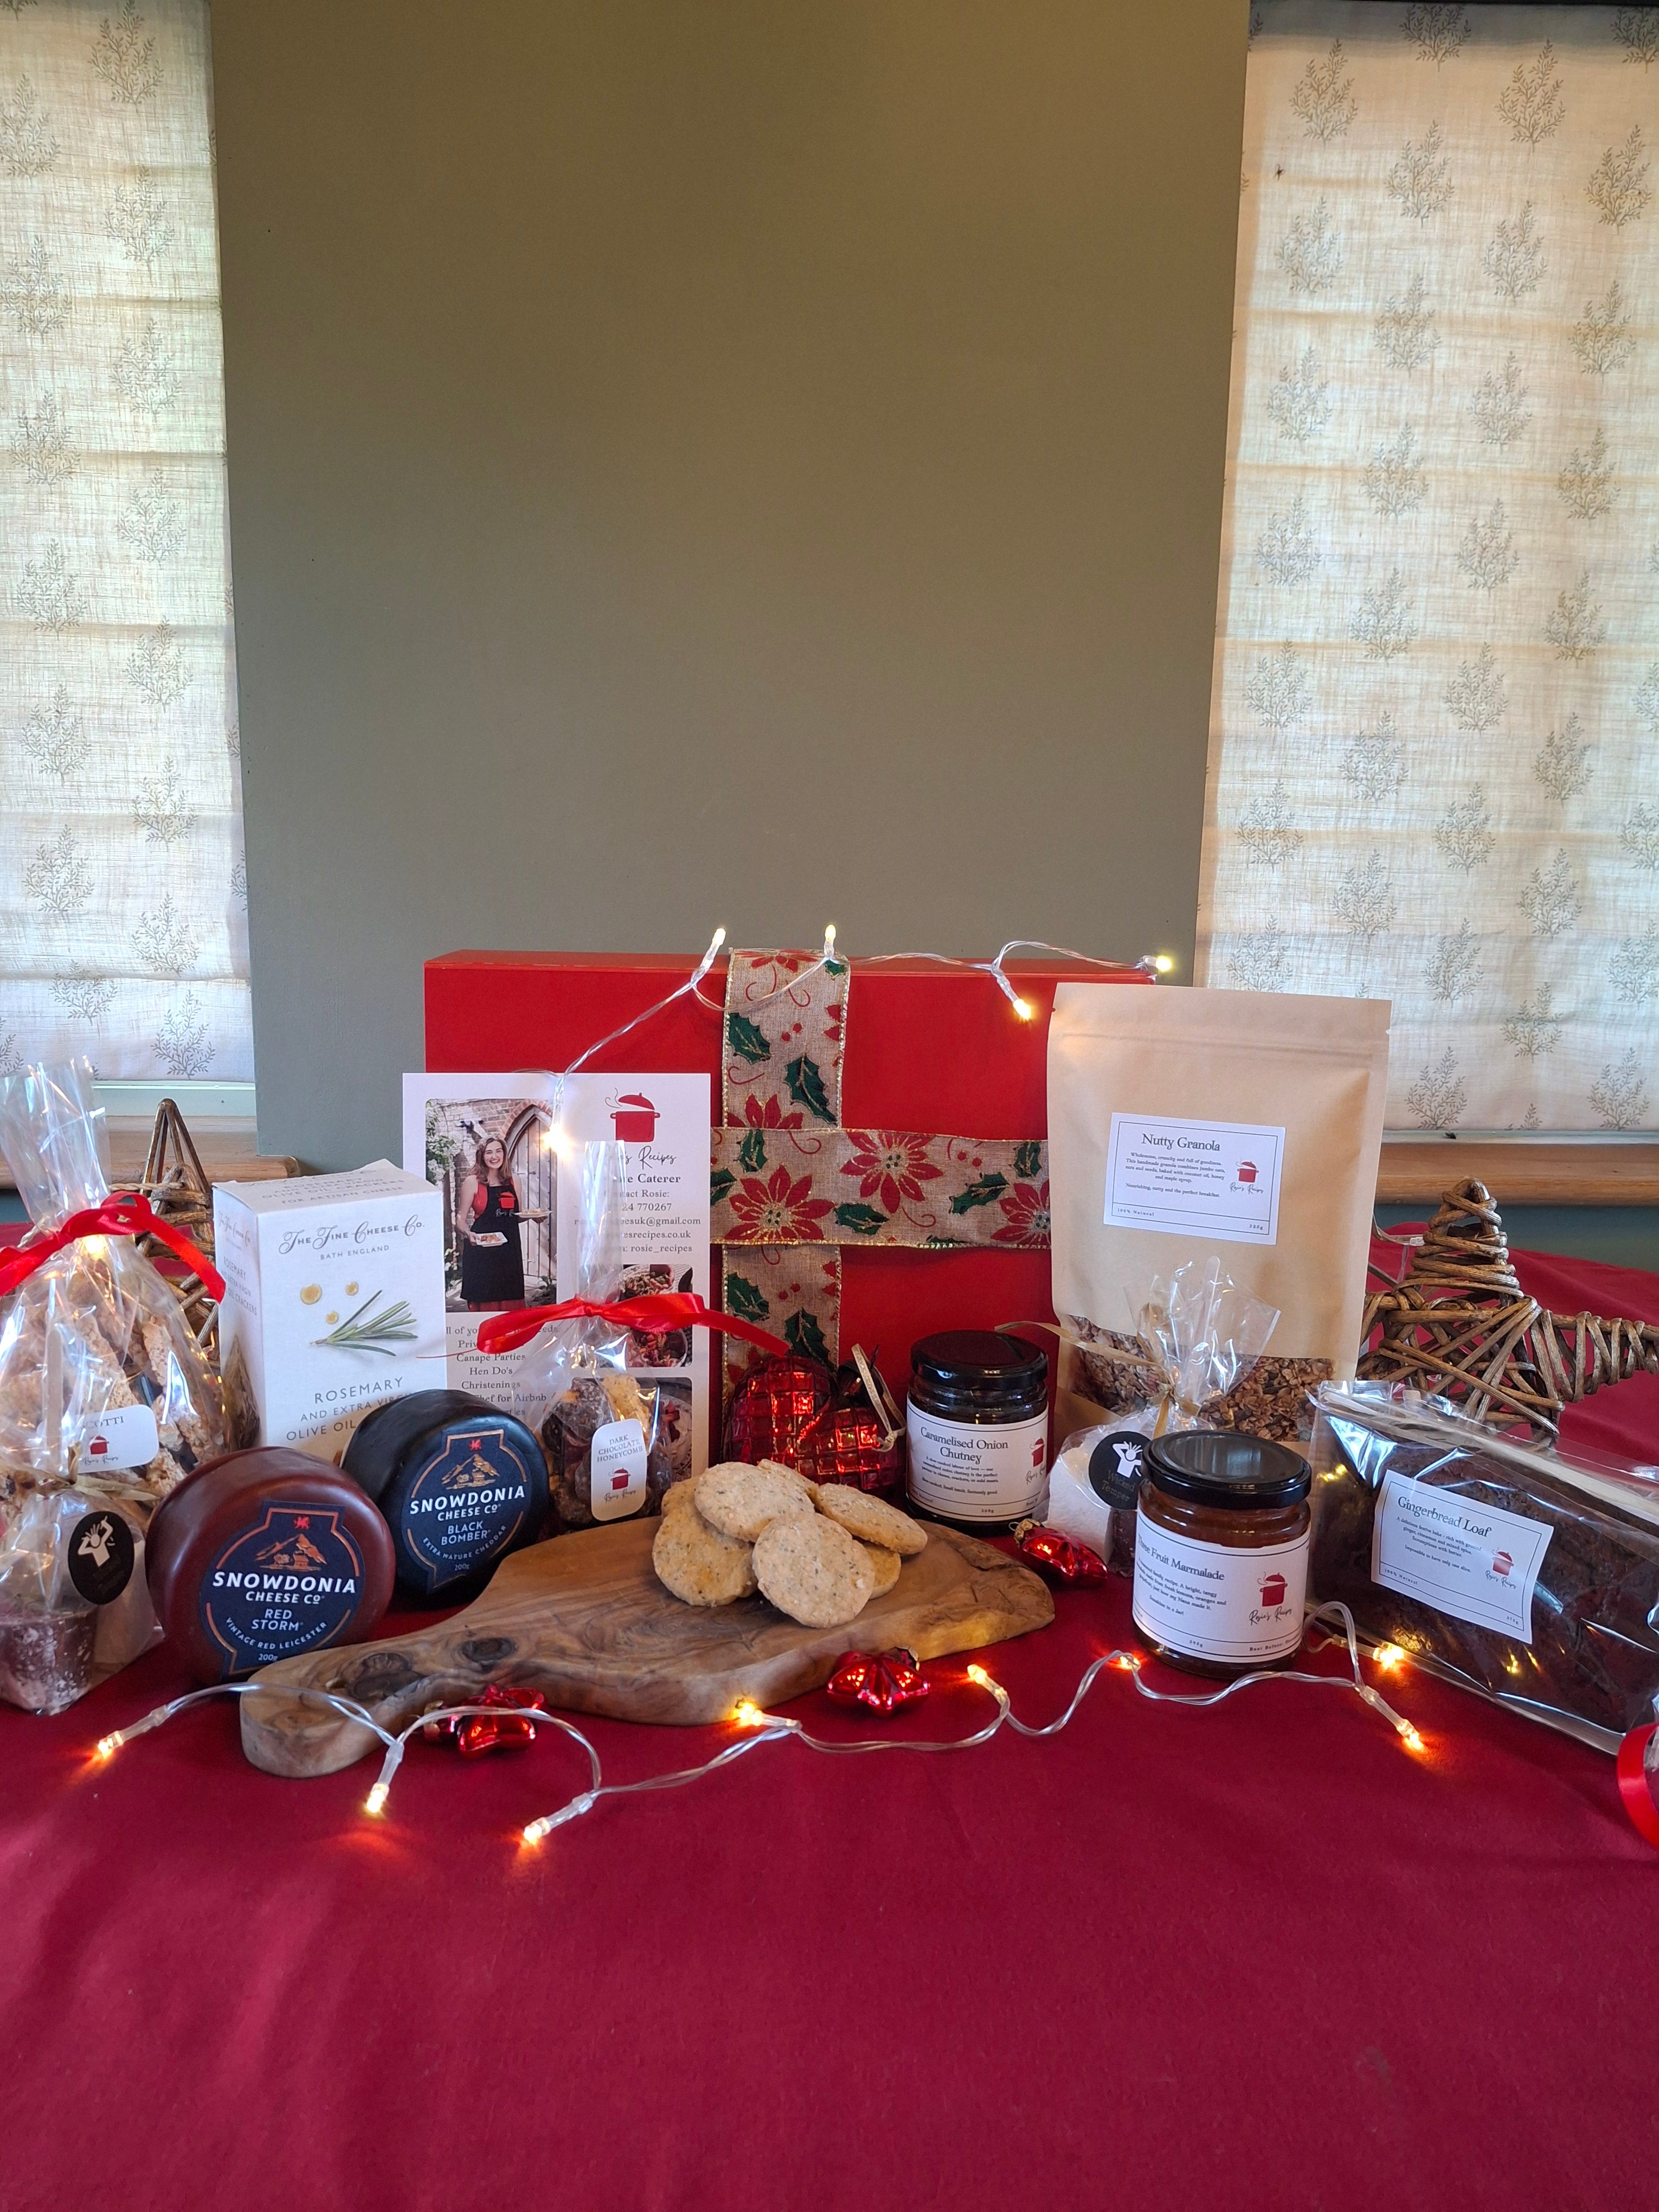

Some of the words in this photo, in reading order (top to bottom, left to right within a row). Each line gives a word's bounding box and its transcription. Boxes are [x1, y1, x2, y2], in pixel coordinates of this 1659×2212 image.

[1141, 1133, 1174, 1150] Nutty
[1177, 1137, 1220, 1152] Granola
[638, 1174, 680, 1183] Caterer
[642, 1189, 670, 1198] Rosie:
[637, 1203, 672, 1211] 770267
[320, 1251, 343, 1260] BATH
[348, 1245, 390, 1256] ENGLAND
[631, 1244, 692, 1253] rosie_recipes
[455, 1326, 465, 1334] of
[467, 1328, 477, 1336] yo
[470, 1367, 488, 1375] Hen
[314, 1377, 403, 1404] ROSEMARY
[461, 1381, 520, 1390] Christenings
[498, 1394, 511, 1402] for
[515, 1393, 546, 1401] Airbnb
[300, 1410, 327, 1422] AND
[333, 1401, 372, 1416] EXTRA
[286, 1425, 327, 1441] OLIVE
[333, 1419, 356, 1432] OIL
[921, 1426, 974, 1449] Caramelised
[976, 1439, 1008, 1449] Onion
[598, 1439, 640, 1455] CHOCOLATE
[609, 1435, 628, 1445] DARK
[597, 1446, 643, 1462] HONEYCOMB
[940, 1446, 982, 1464] Chutney
[1108, 1469, 1136, 1492] Wicked
[1102, 1480, 1130, 1502] Temper
[410, 1486, 525, 1514] SNOWDONIA
[438, 1507, 481, 1521] CHEESE
[1398, 1496, 1463, 1528] Gingerbread
[1462, 1519, 1492, 1538] Loaf
[447, 1520, 484, 1534] BLACK
[423, 1537, 441, 1556] EXTRA
[442, 1552, 472, 1560] MATURE
[475, 1525, 506, 1555] CHEDDAR
[441, 1531, 488, 1545] BOMBER
[1151, 1547, 1169, 1565] Fruit
[1171, 1558, 1225, 1580] Marmalade
[213, 1572, 356, 1593] SNOWDONIA
[246, 1591, 300, 1604] CHEESE
[265, 1609, 292, 1619] RED
[251, 1619, 299, 1631] STORM
[226, 1617, 256, 1646] VINTAGE
[257, 1641, 275, 1649] RED
[279, 1622, 327, 1649] LEICESTER
